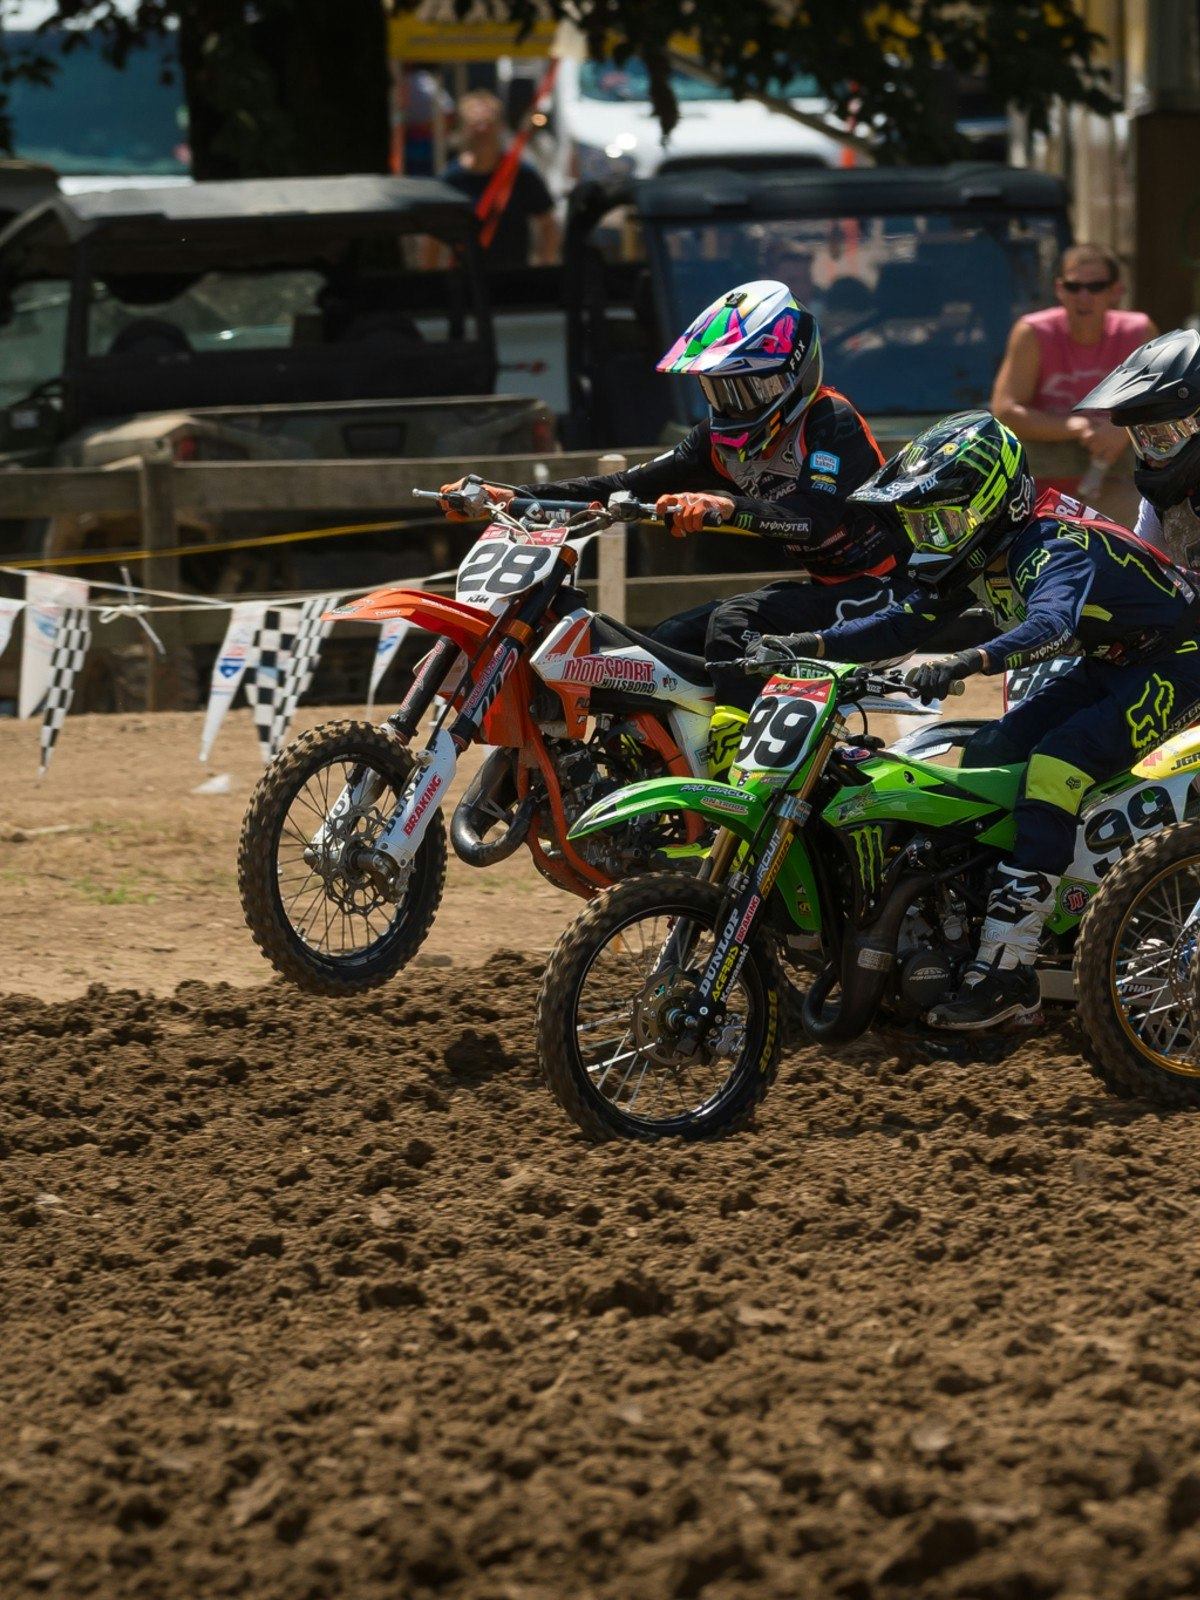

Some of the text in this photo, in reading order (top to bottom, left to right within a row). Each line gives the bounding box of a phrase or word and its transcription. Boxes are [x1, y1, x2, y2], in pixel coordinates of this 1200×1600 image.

[789, 339, 806, 371] FOX
[919, 473, 940, 494] FOX
[759, 520, 809, 533] MONSTER
[458, 542, 552, 594] 28
[467, 594, 489, 605] KTM
[1029, 630, 1073, 661] MONSTER
[601, 678, 657, 696] HILLSBORO
[735, 696, 818, 768] 99
[402, 774, 443, 837] BRAKING
[679, 783, 757, 803] PRO CIRCUIT
[736, 895, 760, 944] BRAKING
[700, 908, 740, 998] DUNLOP
[720, 943, 749, 1002] Kawasaki
